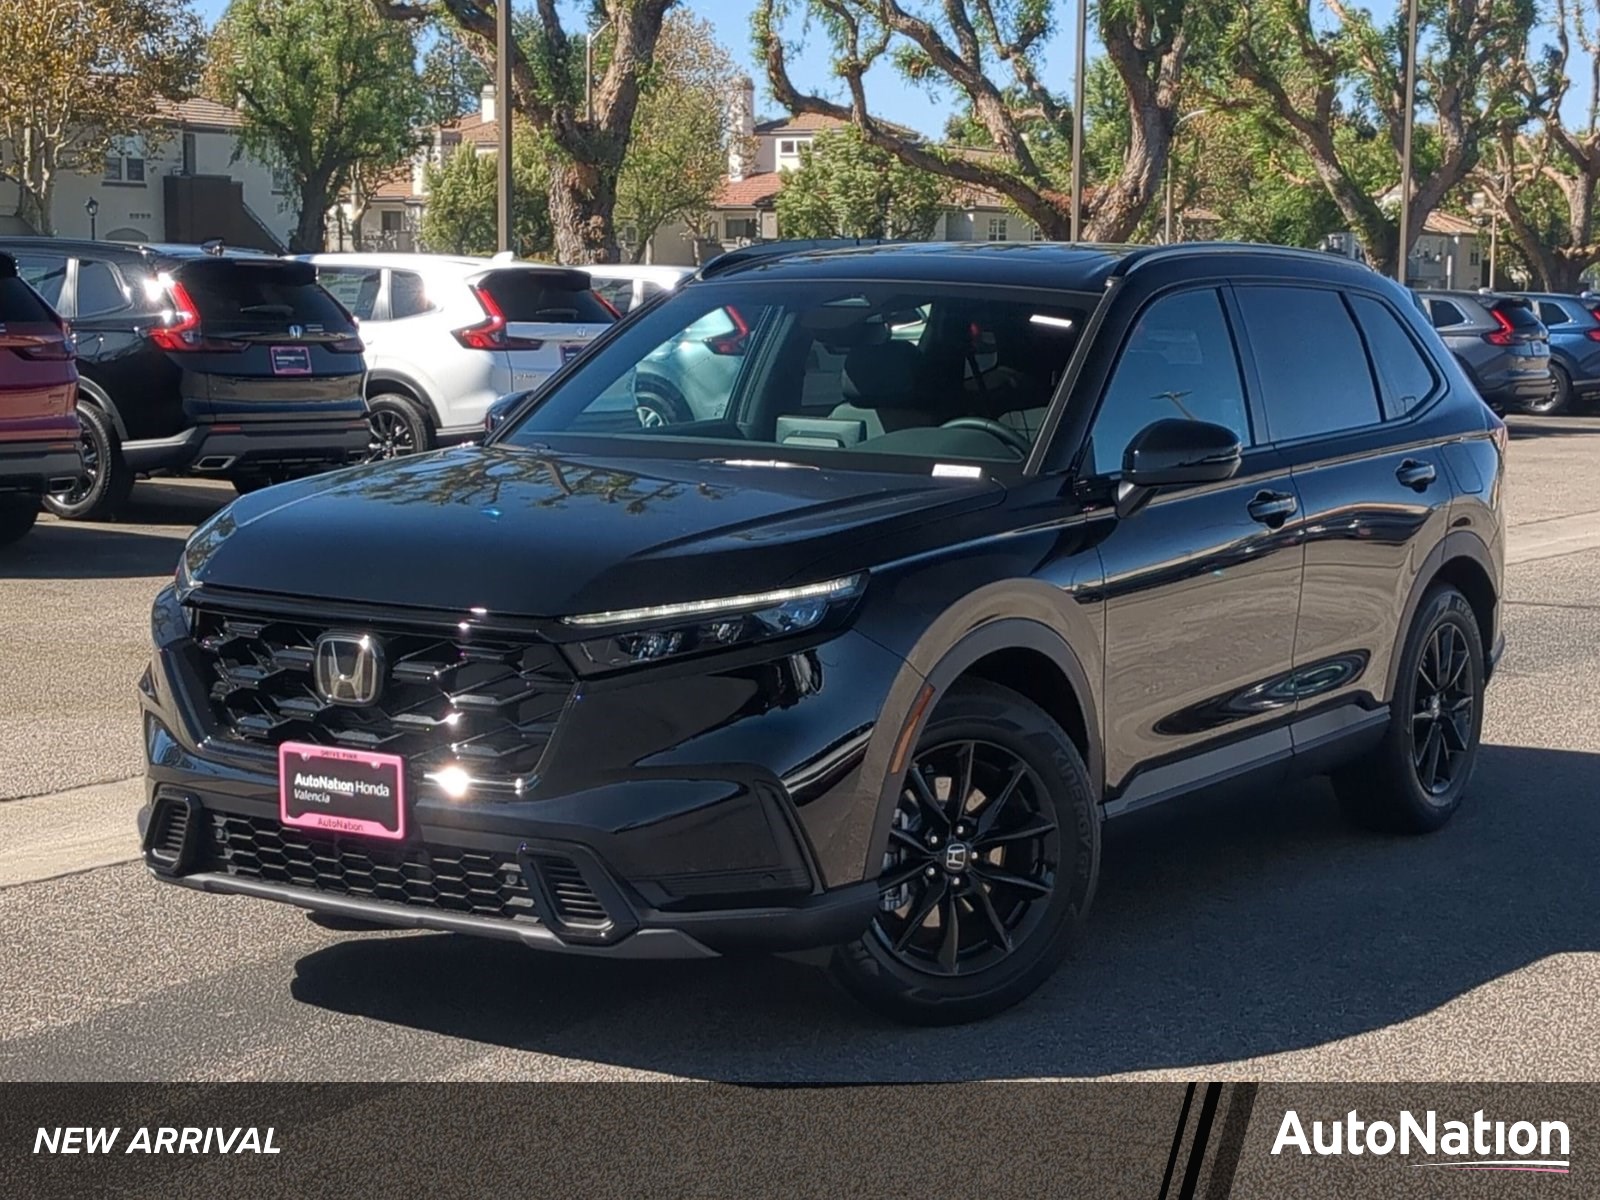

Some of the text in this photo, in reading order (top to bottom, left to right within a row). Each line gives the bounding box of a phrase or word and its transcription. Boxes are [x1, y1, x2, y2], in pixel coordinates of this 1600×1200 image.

[294, 772, 390, 797] AutoNation Honda
[294, 788, 331, 803] Valencia
[317, 817, 364, 832] AutoNation
